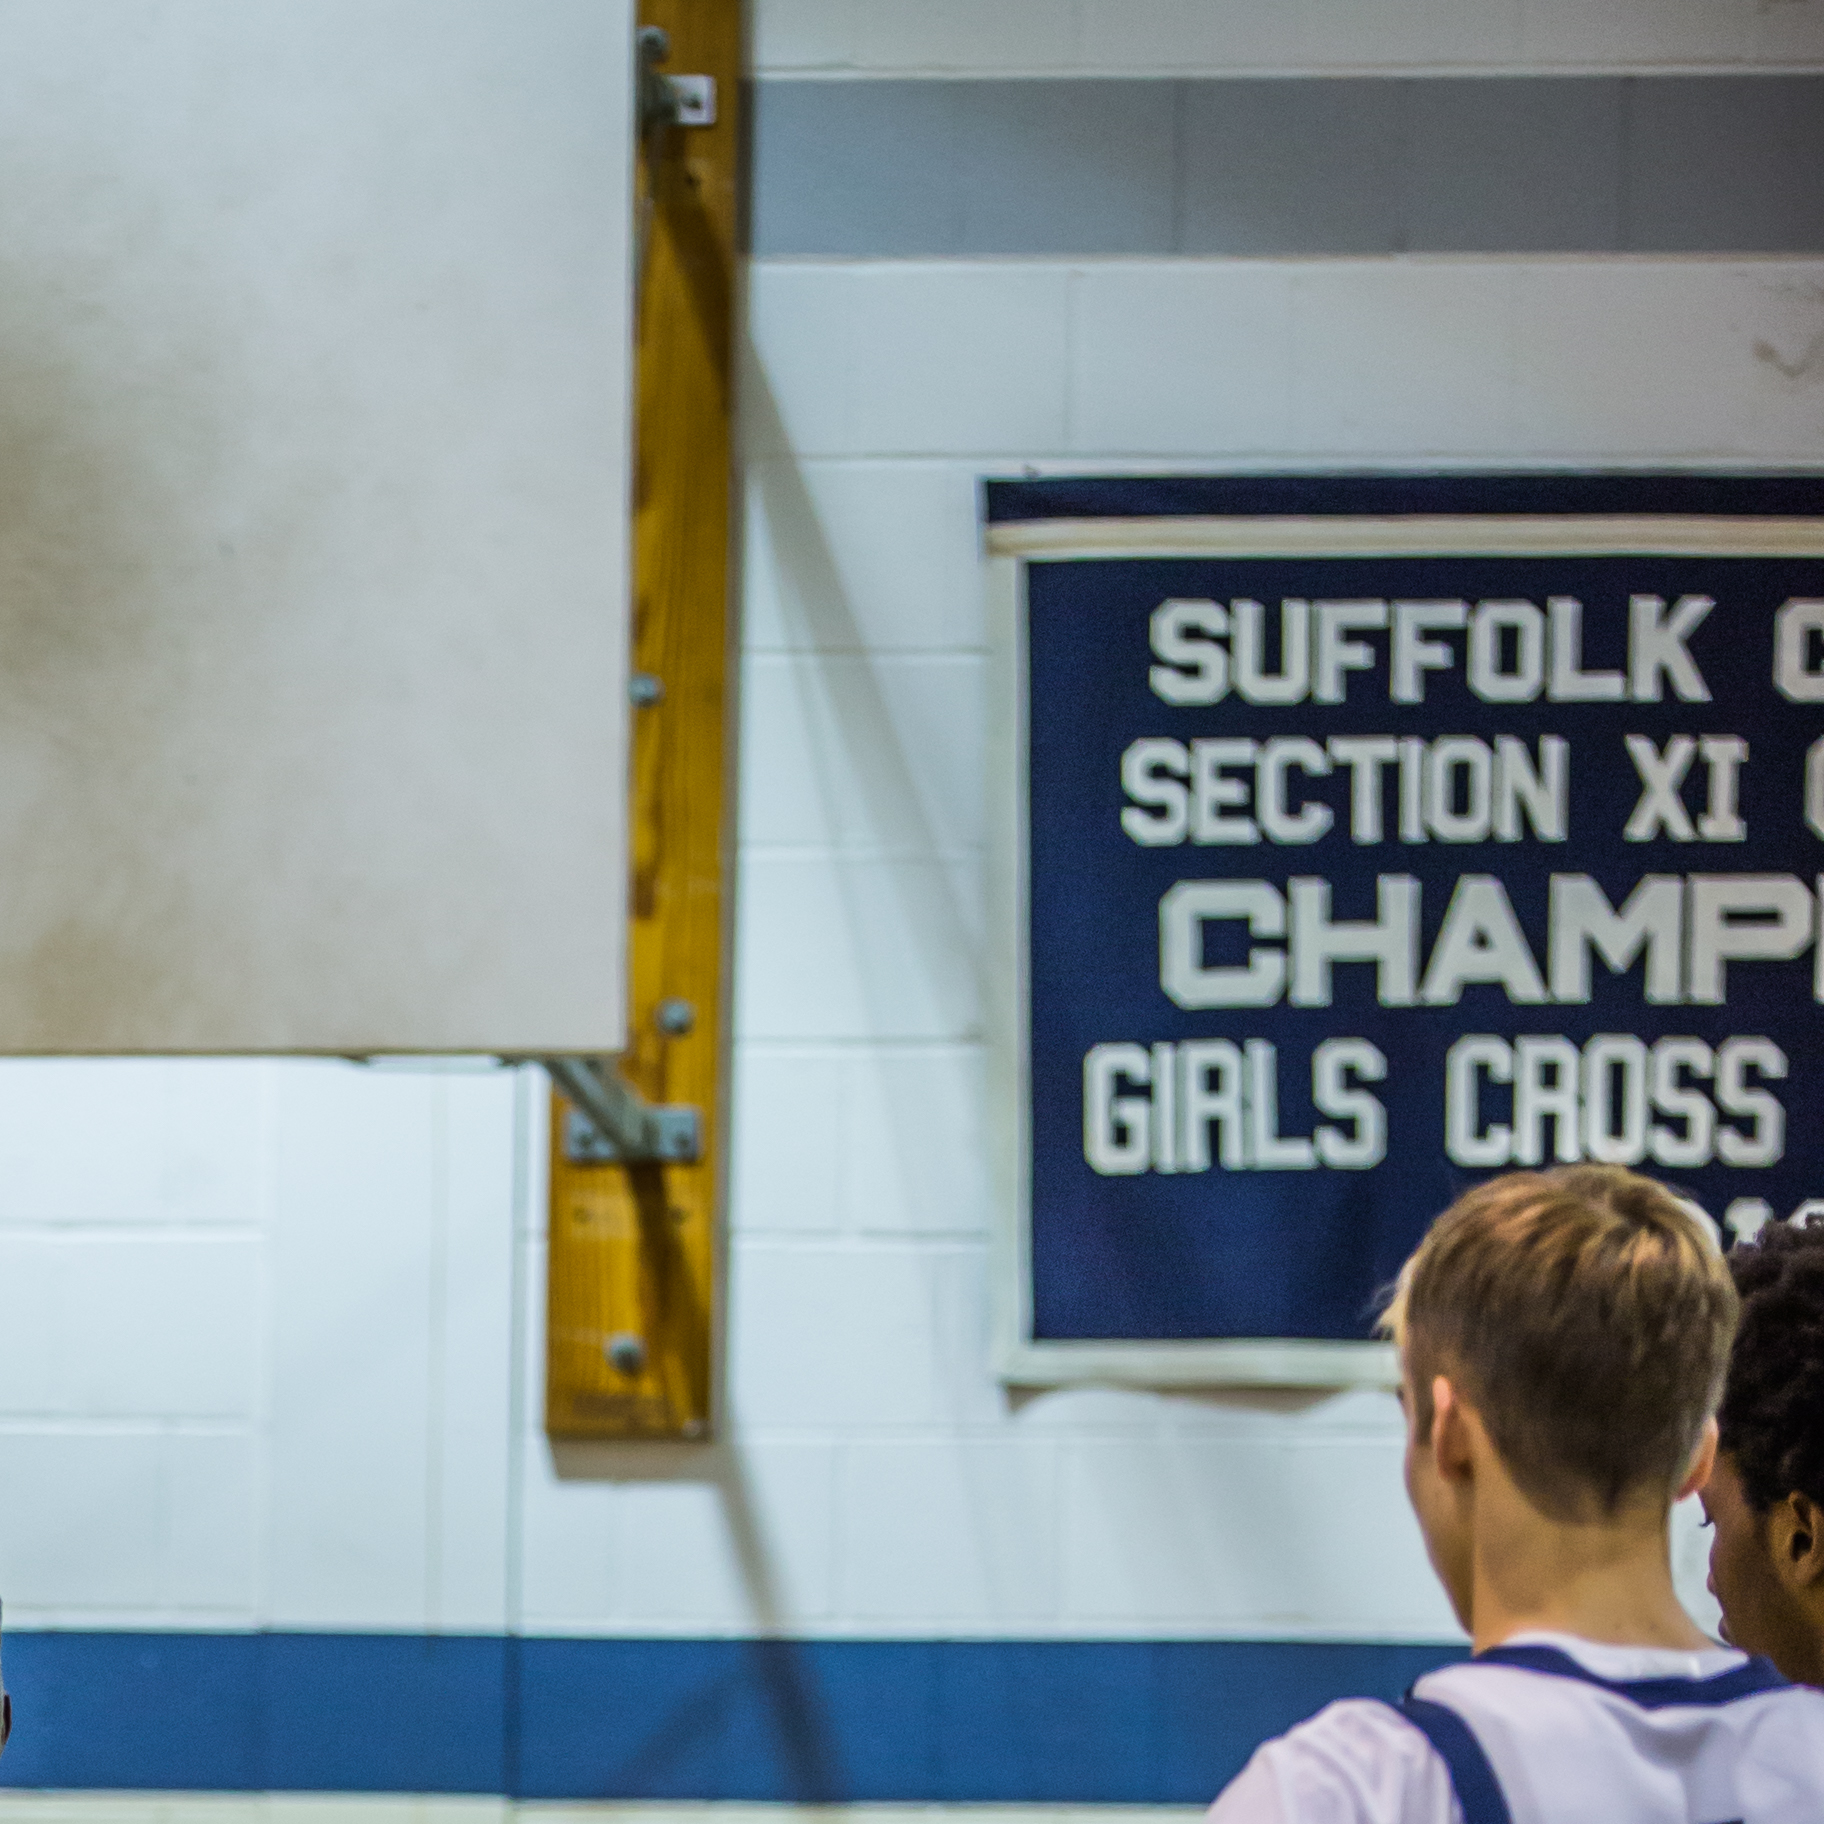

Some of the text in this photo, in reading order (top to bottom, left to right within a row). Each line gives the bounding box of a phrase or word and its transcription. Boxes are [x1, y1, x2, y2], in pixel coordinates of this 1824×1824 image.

[1148, 594, 1716, 706] SUFFOLK
[1120, 734, 1570, 847] SECTION
[1624, 734, 1749, 843] XI
[1158, 873, 1824, 1011] CHAMP
[1082, 1033, 1789, 1176] GIRLS CROSS
